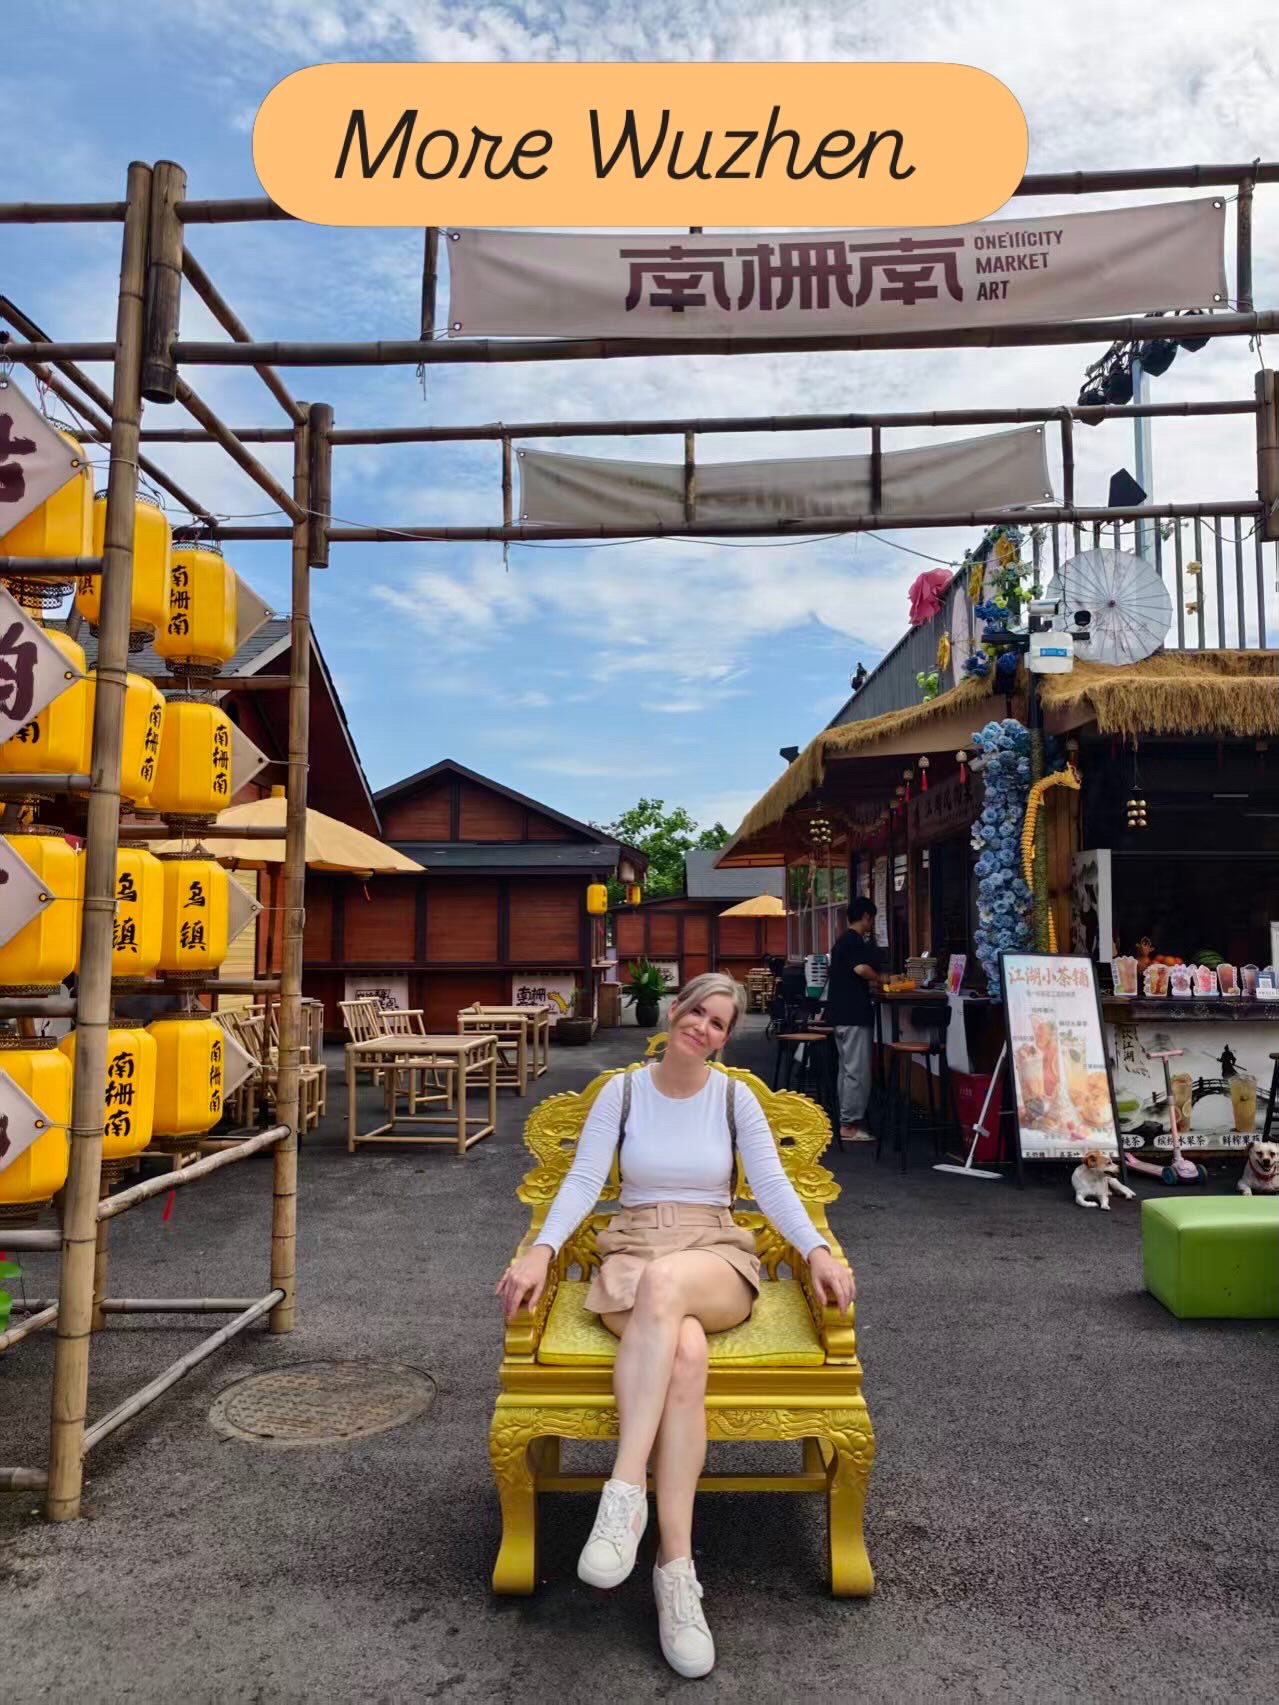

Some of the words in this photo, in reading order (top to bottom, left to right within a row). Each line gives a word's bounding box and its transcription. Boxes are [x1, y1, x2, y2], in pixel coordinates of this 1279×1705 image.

[976, 252, 1050, 274] MARKET
[977, 279, 1011, 302] ART
[1008, 966, 1090, 987] 江湖小茶铺
